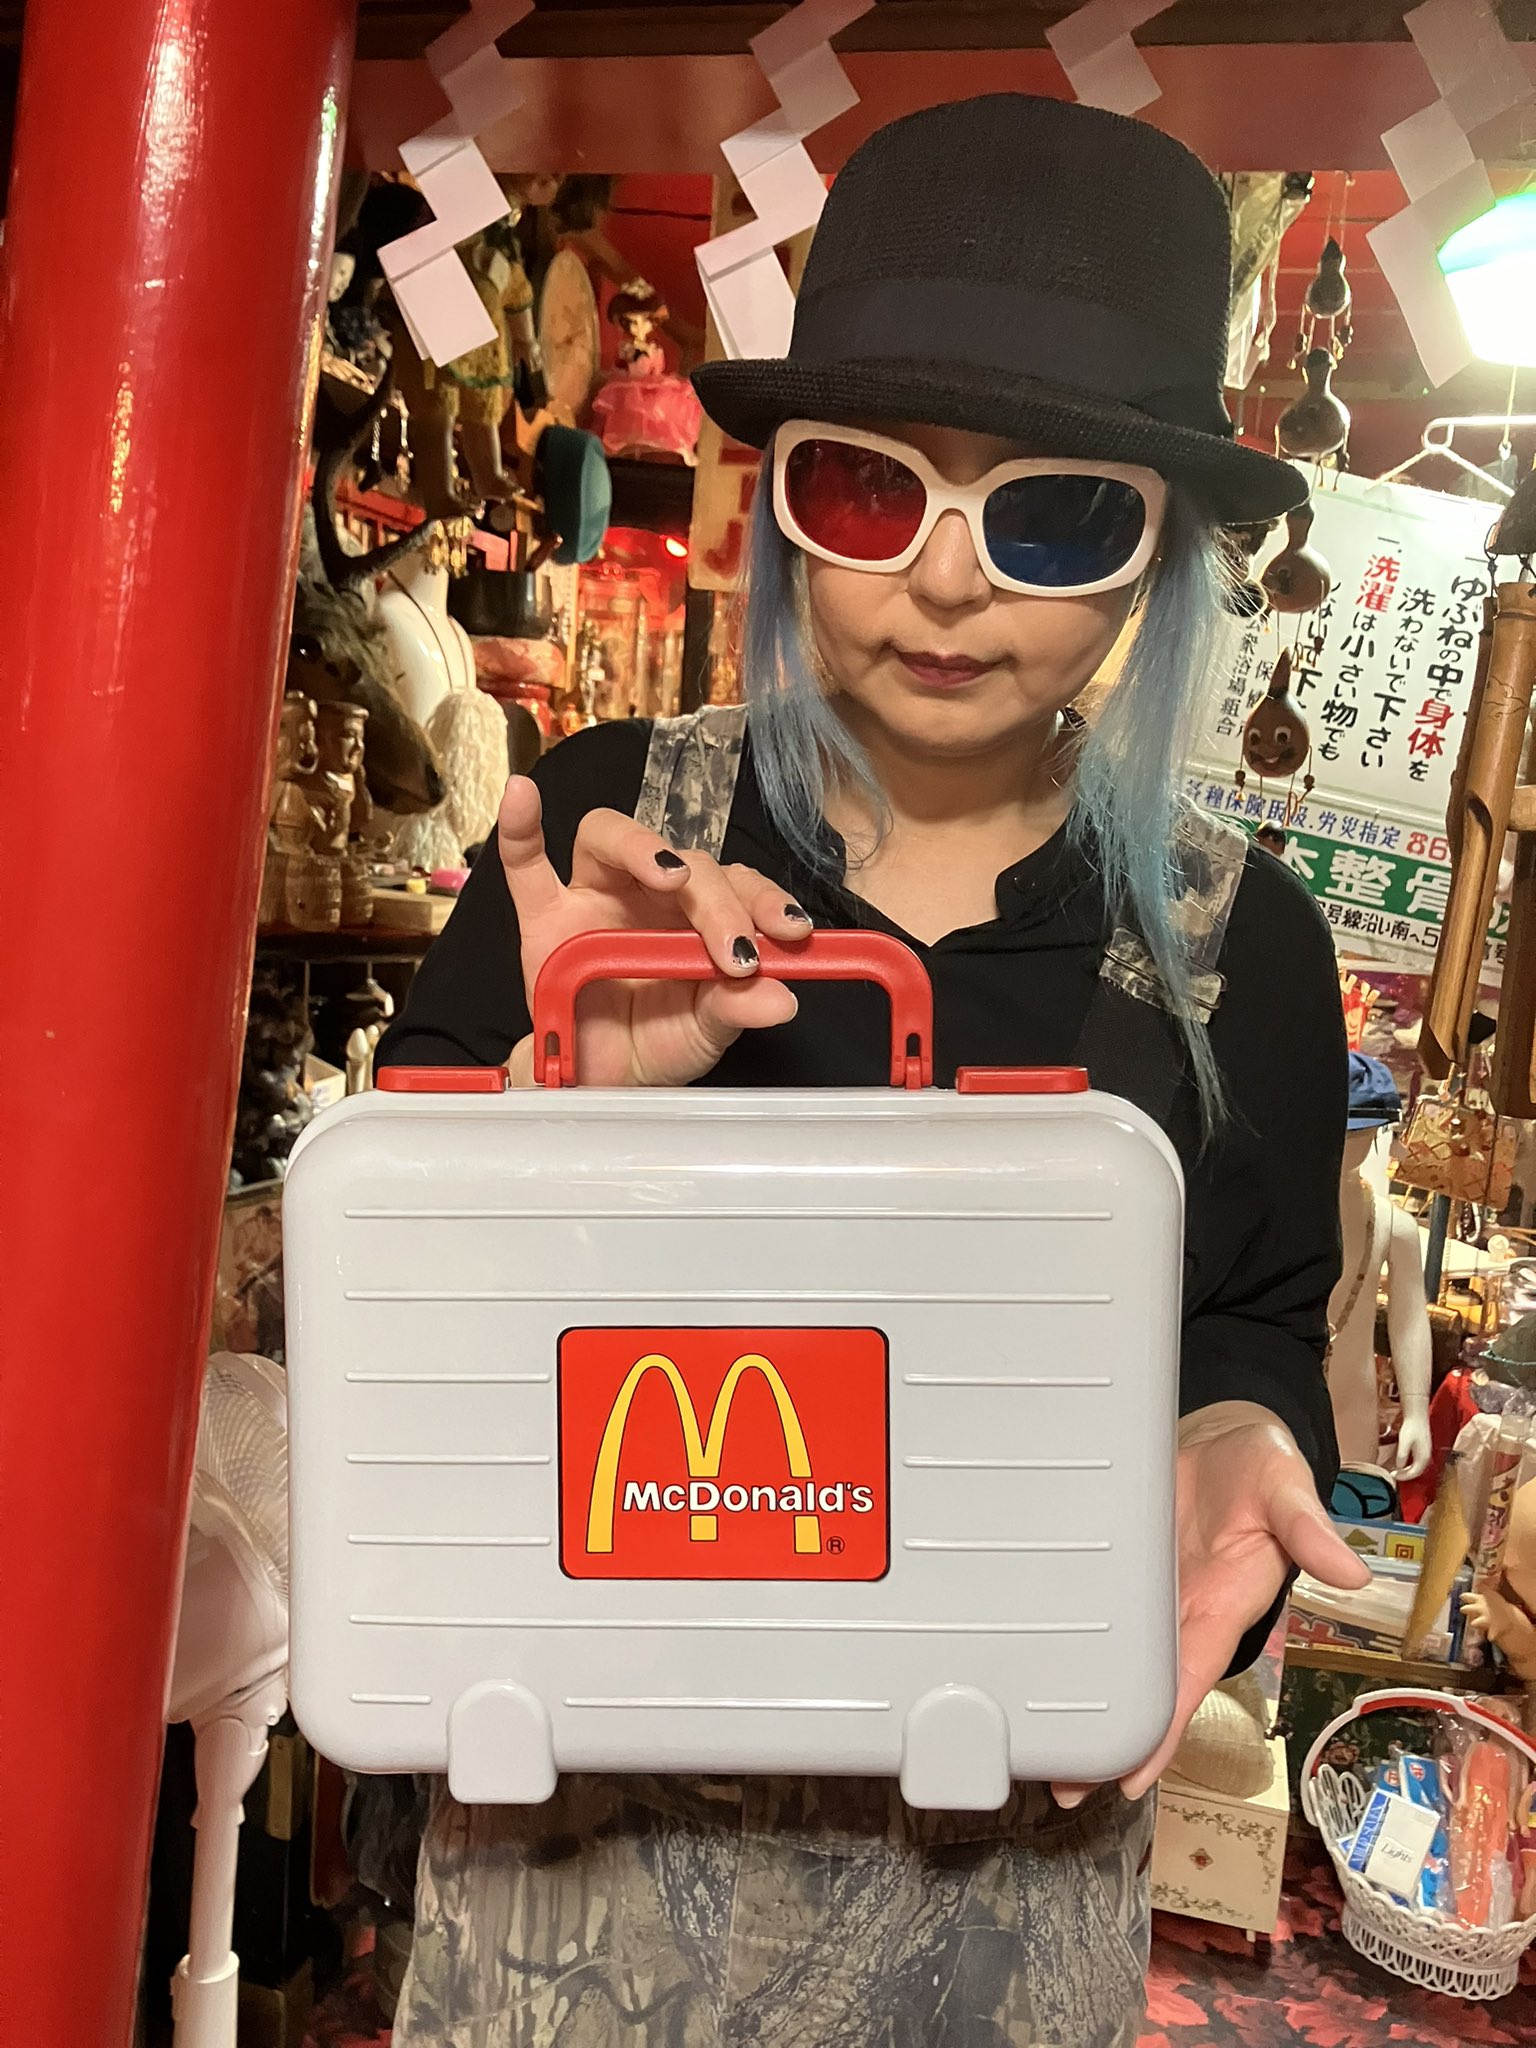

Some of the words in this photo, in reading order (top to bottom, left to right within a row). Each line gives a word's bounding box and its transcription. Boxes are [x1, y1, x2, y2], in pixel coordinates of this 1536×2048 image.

[1361, 587, 1436, 768] 洗わないで下さい
[622, 1481, 875, 1513] McDonald's
[1381, 1843, 1413, 1864] Lights
